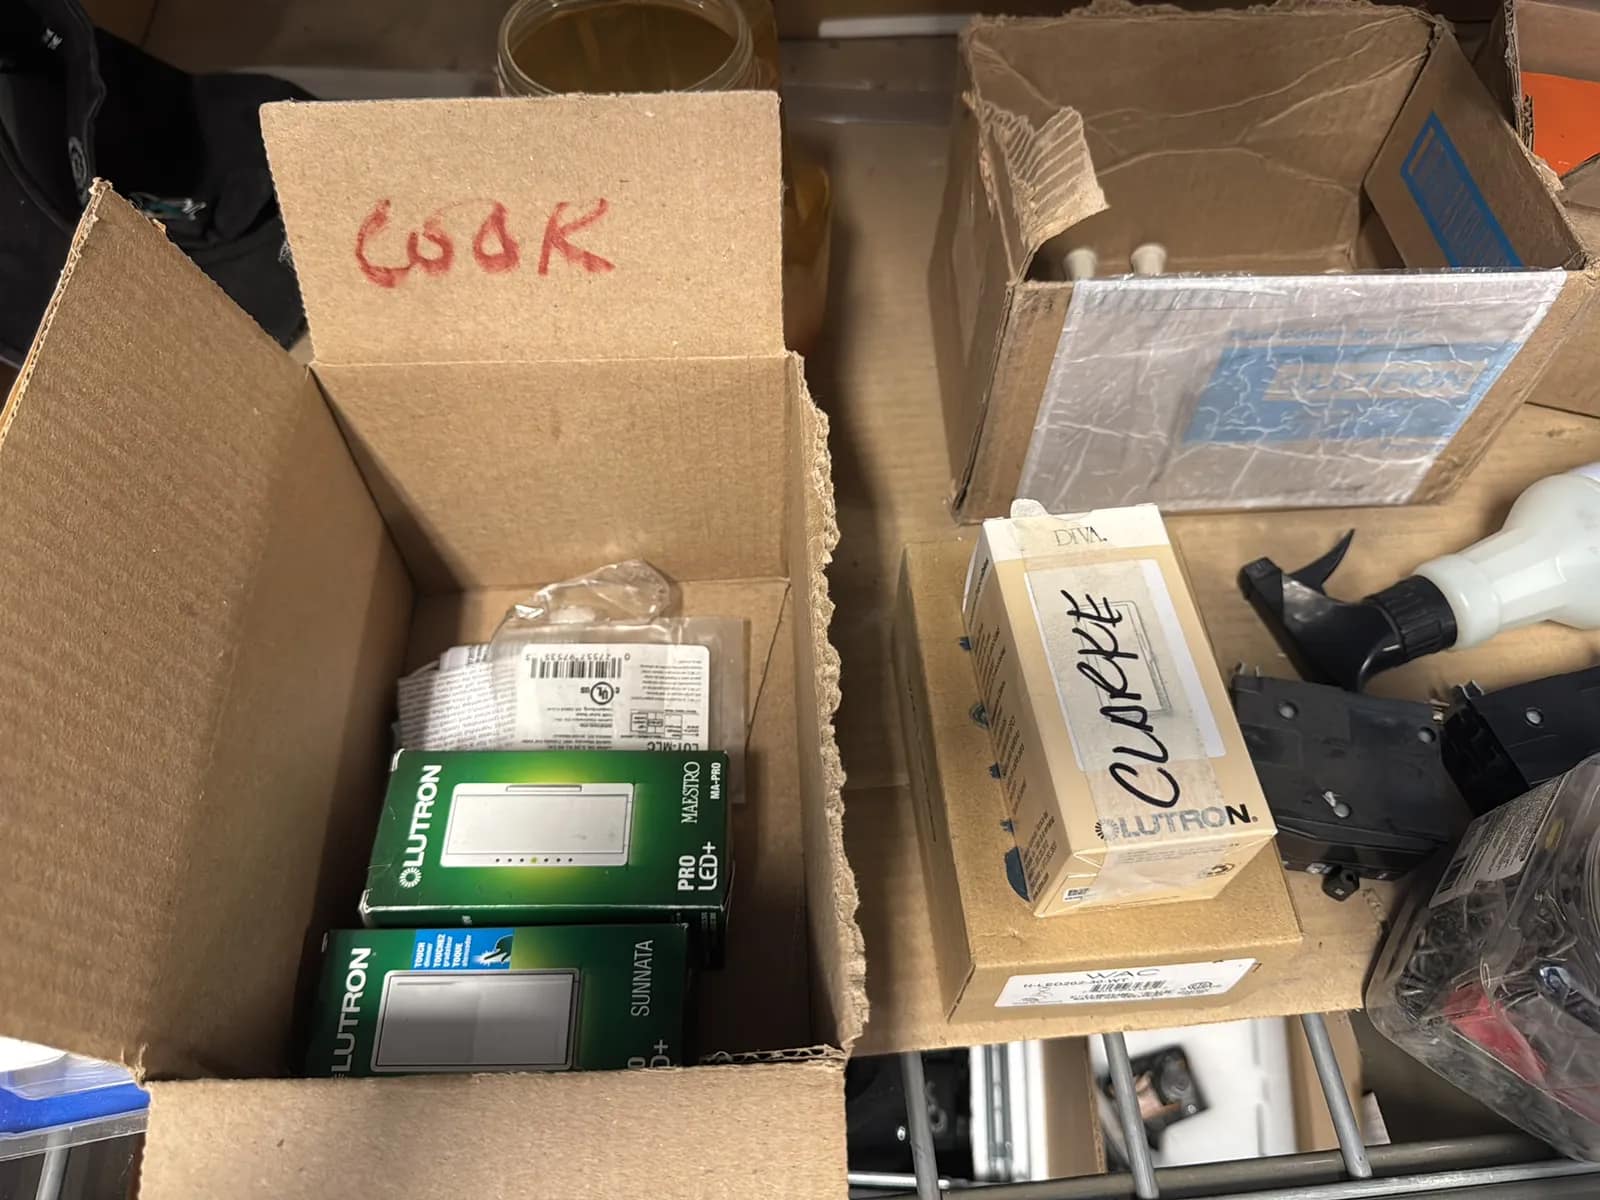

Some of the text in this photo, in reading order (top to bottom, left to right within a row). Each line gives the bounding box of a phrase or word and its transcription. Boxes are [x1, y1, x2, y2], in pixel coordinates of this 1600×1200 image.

[355, 198, 615, 288] COOK
[1060, 589, 1180, 808] CLARKE
[681, 761, 700, 824] MAESTRO
[710, 762, 721, 800] MA-PRO
[403, 764, 442, 867] LUTRON
[1120, 803, 1249, 837] LUTRON
[677, 855, 696, 891] PRO
[698, 841, 718, 891] LED+
[414, 942, 426, 968] TOUCH
[433, 934, 446, 968] TOUCHEZ
[452, 943, 463, 968] TOQUE
[631, 940, 653, 1016] SUNNATA
[1086, 968, 1161, 980] WAC
[331, 947, 371, 1072] LUTRON
